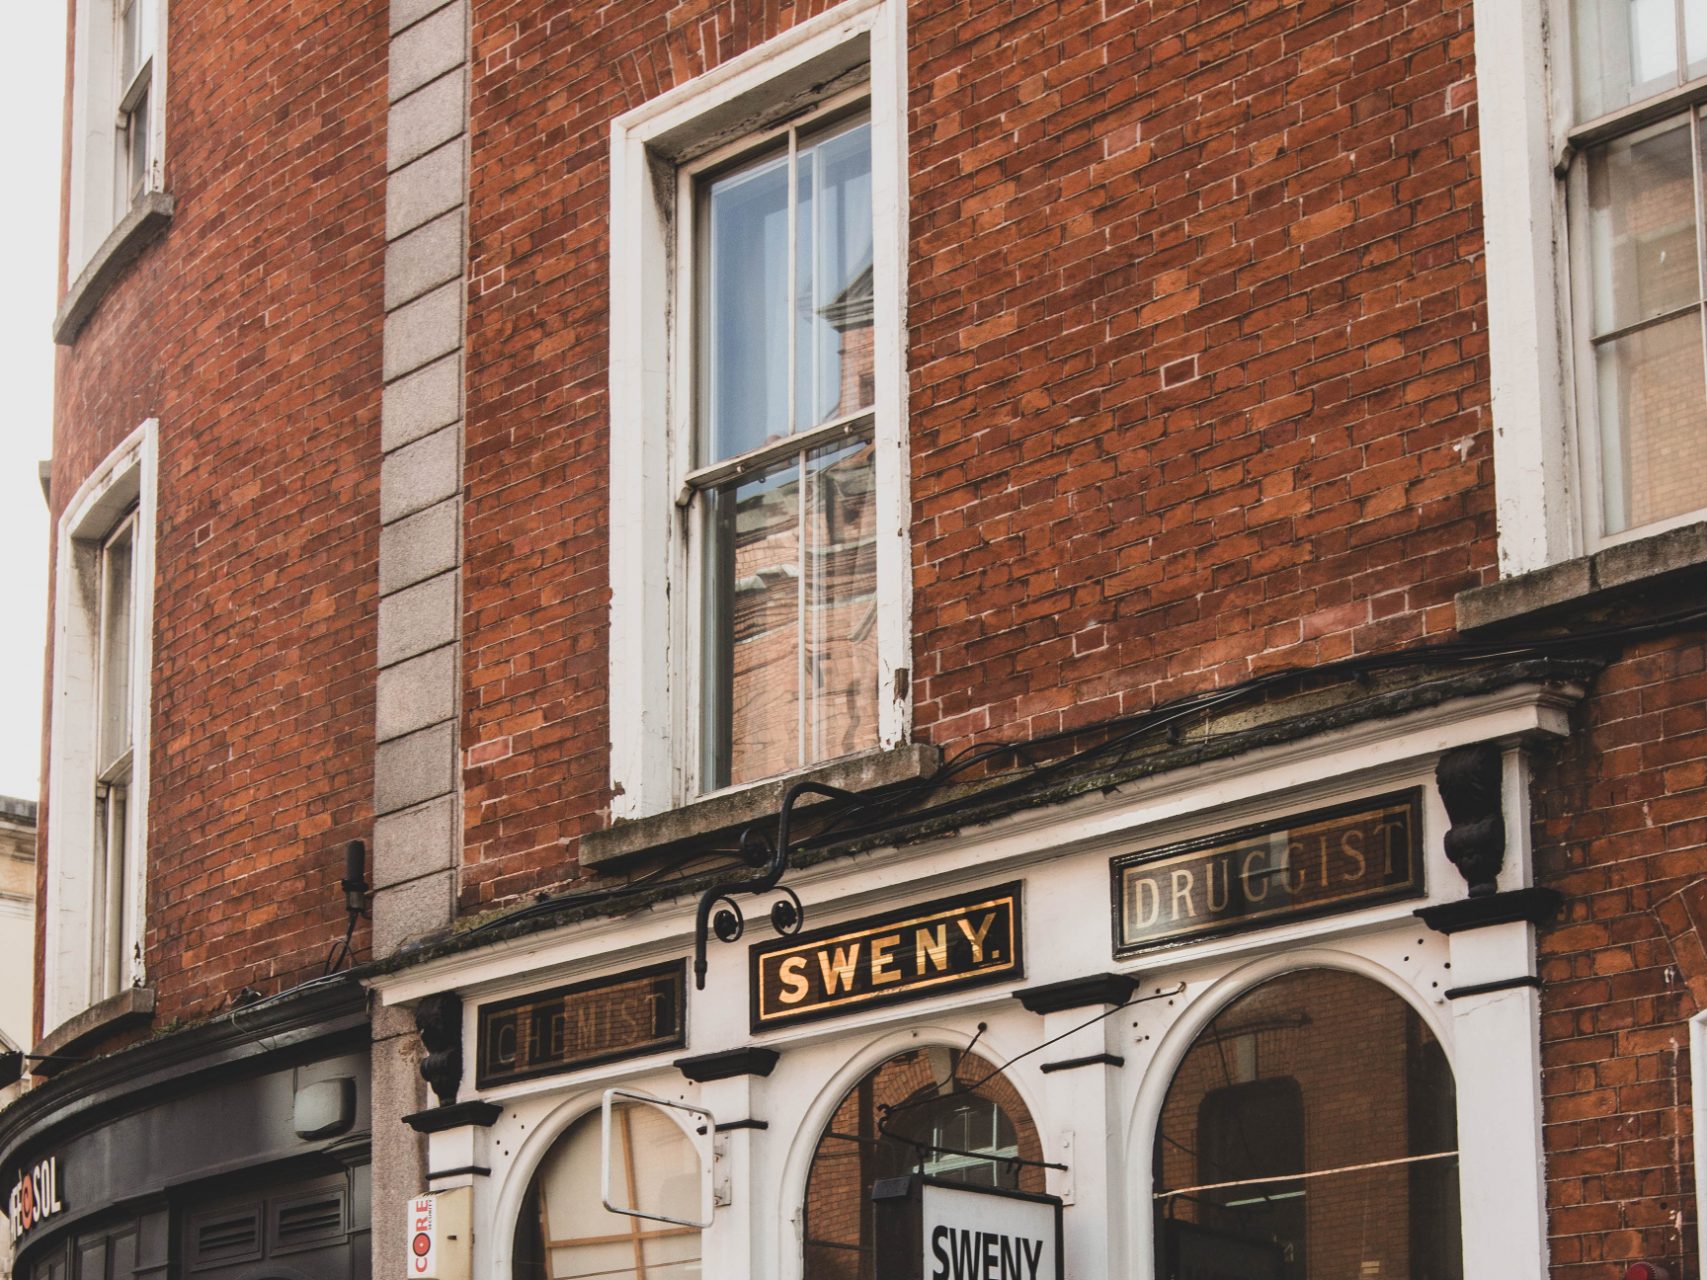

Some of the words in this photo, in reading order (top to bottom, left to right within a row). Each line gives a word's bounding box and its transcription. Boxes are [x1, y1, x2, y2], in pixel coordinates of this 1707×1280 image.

[1135, 820, 1403, 930] DRUGGIST
[498, 993, 665, 1064] CHEMIST
[33, 1156, 61, 1222] SOL
